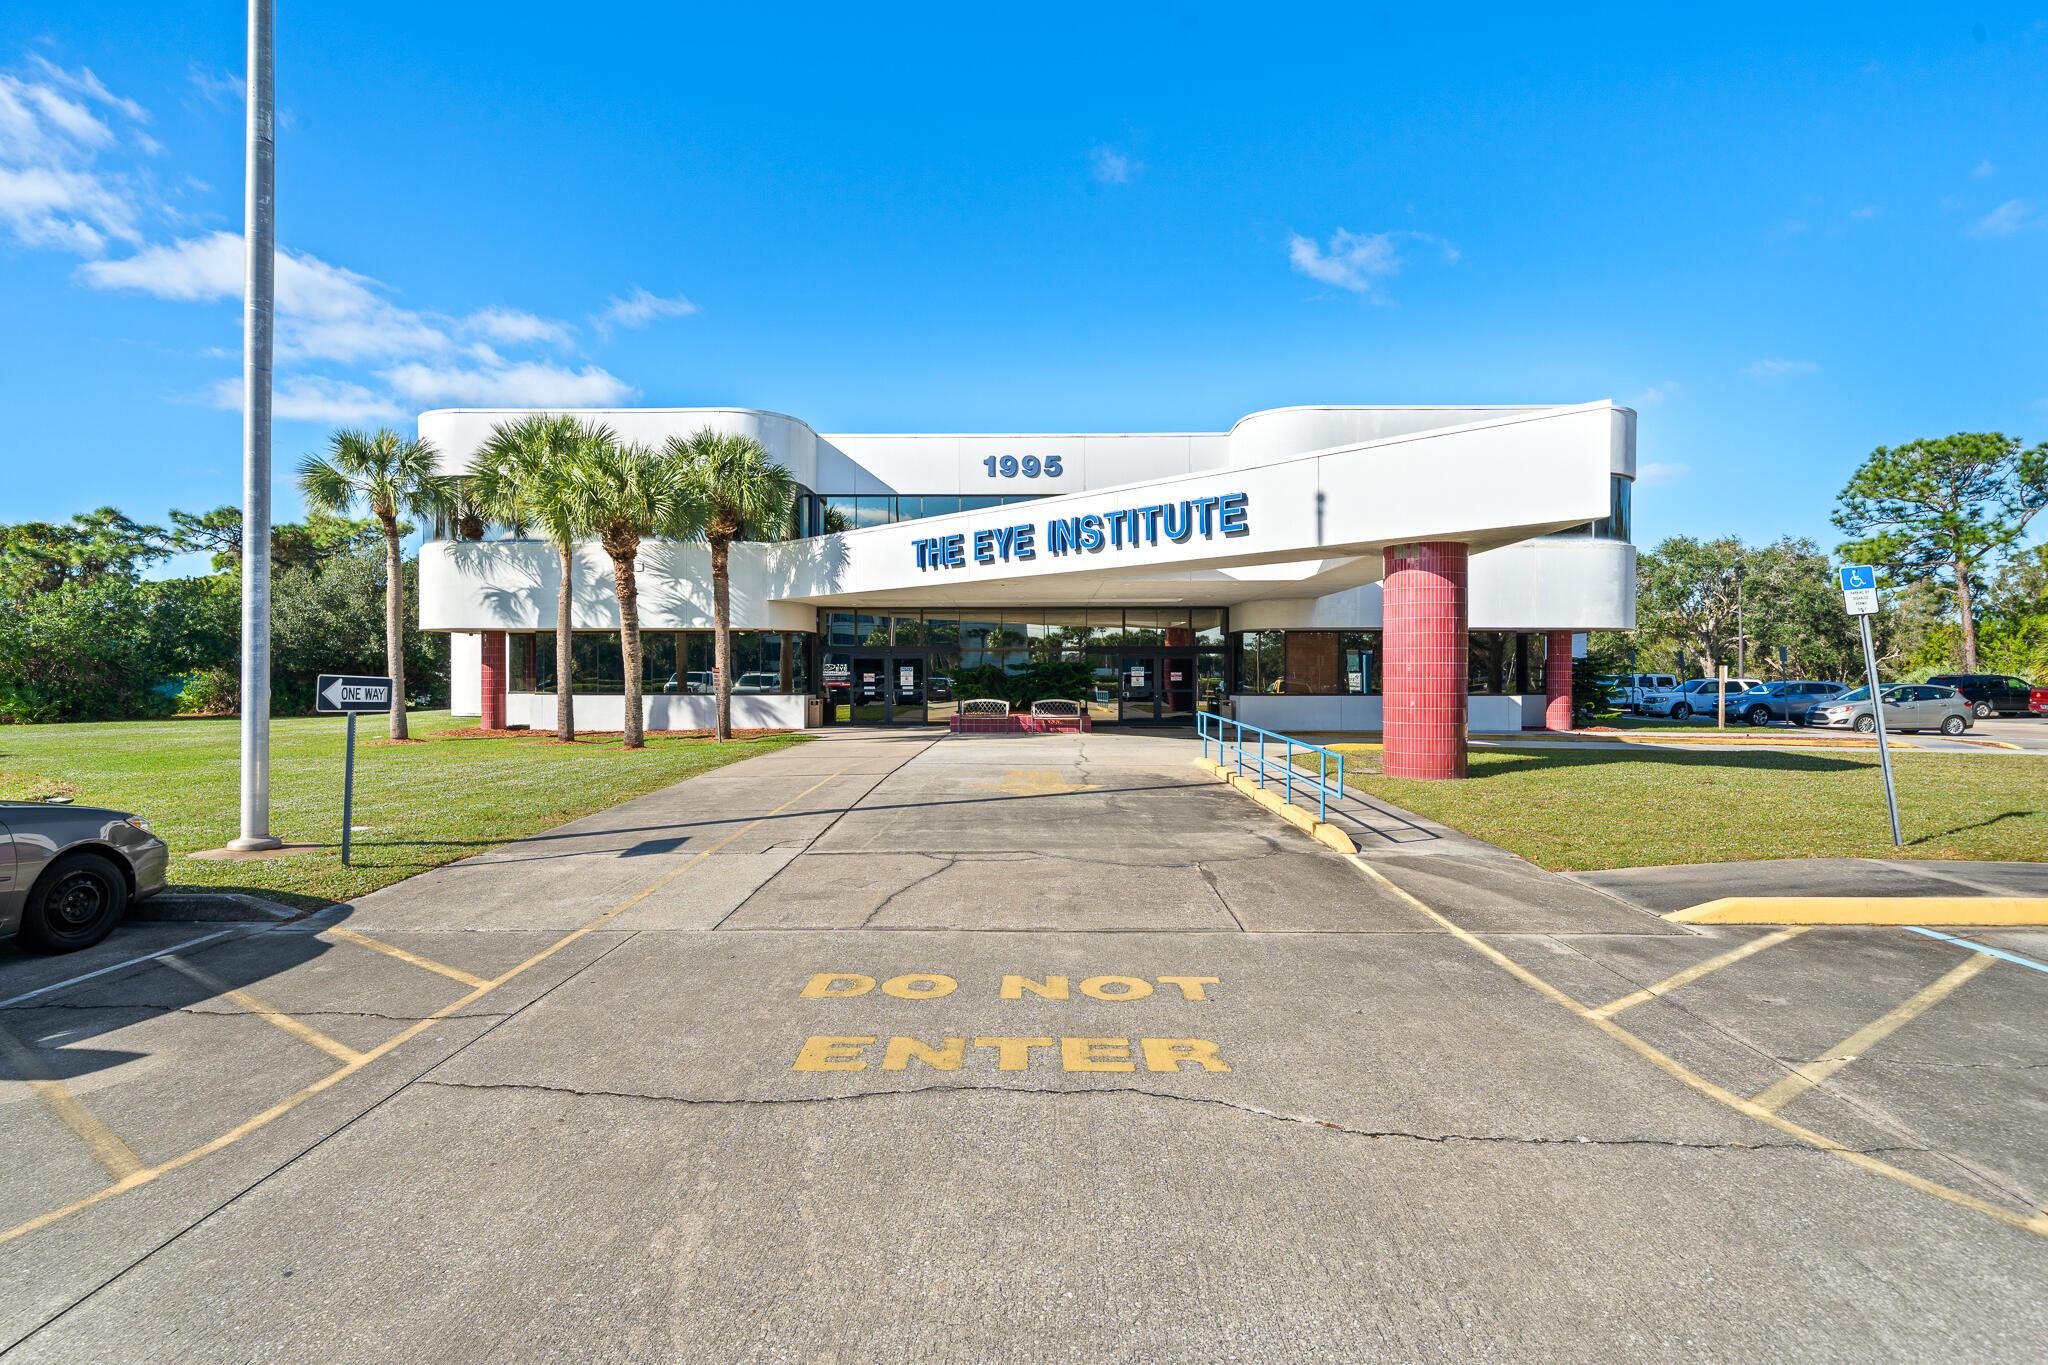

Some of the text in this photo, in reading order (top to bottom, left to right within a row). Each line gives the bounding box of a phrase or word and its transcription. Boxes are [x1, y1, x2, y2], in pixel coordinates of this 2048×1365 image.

[983, 455, 1063, 478] 1995
[911, 492, 1249, 571] THE EYE INSTITUTE
[341, 687, 385, 700] ONE WAY
[800, 973, 1221, 1001] DO NOT
[792, 1036, 1232, 1072] ENTER
